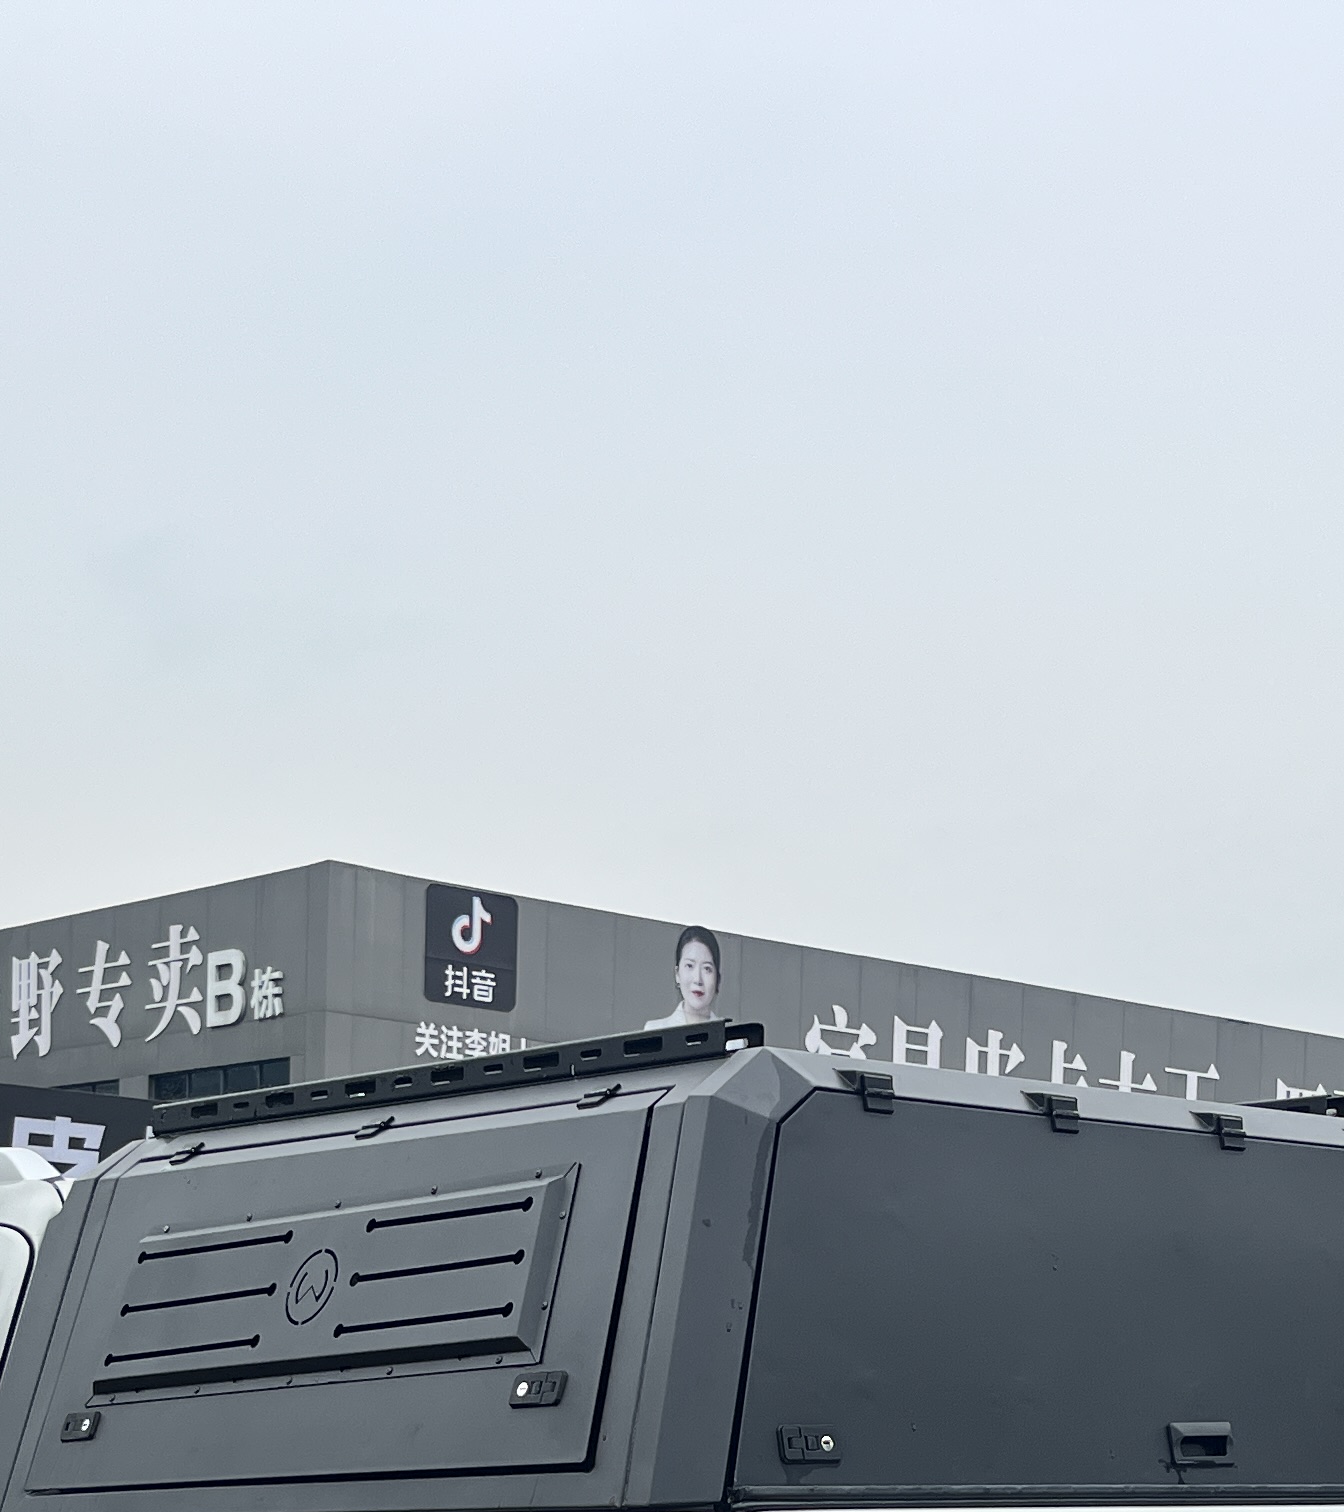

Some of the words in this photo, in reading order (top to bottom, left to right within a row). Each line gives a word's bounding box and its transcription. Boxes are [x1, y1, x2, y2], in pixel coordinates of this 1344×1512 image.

[443, 964, 498, 1004] 抖音
[414, 1020, 527, 1060] 关注李姐
